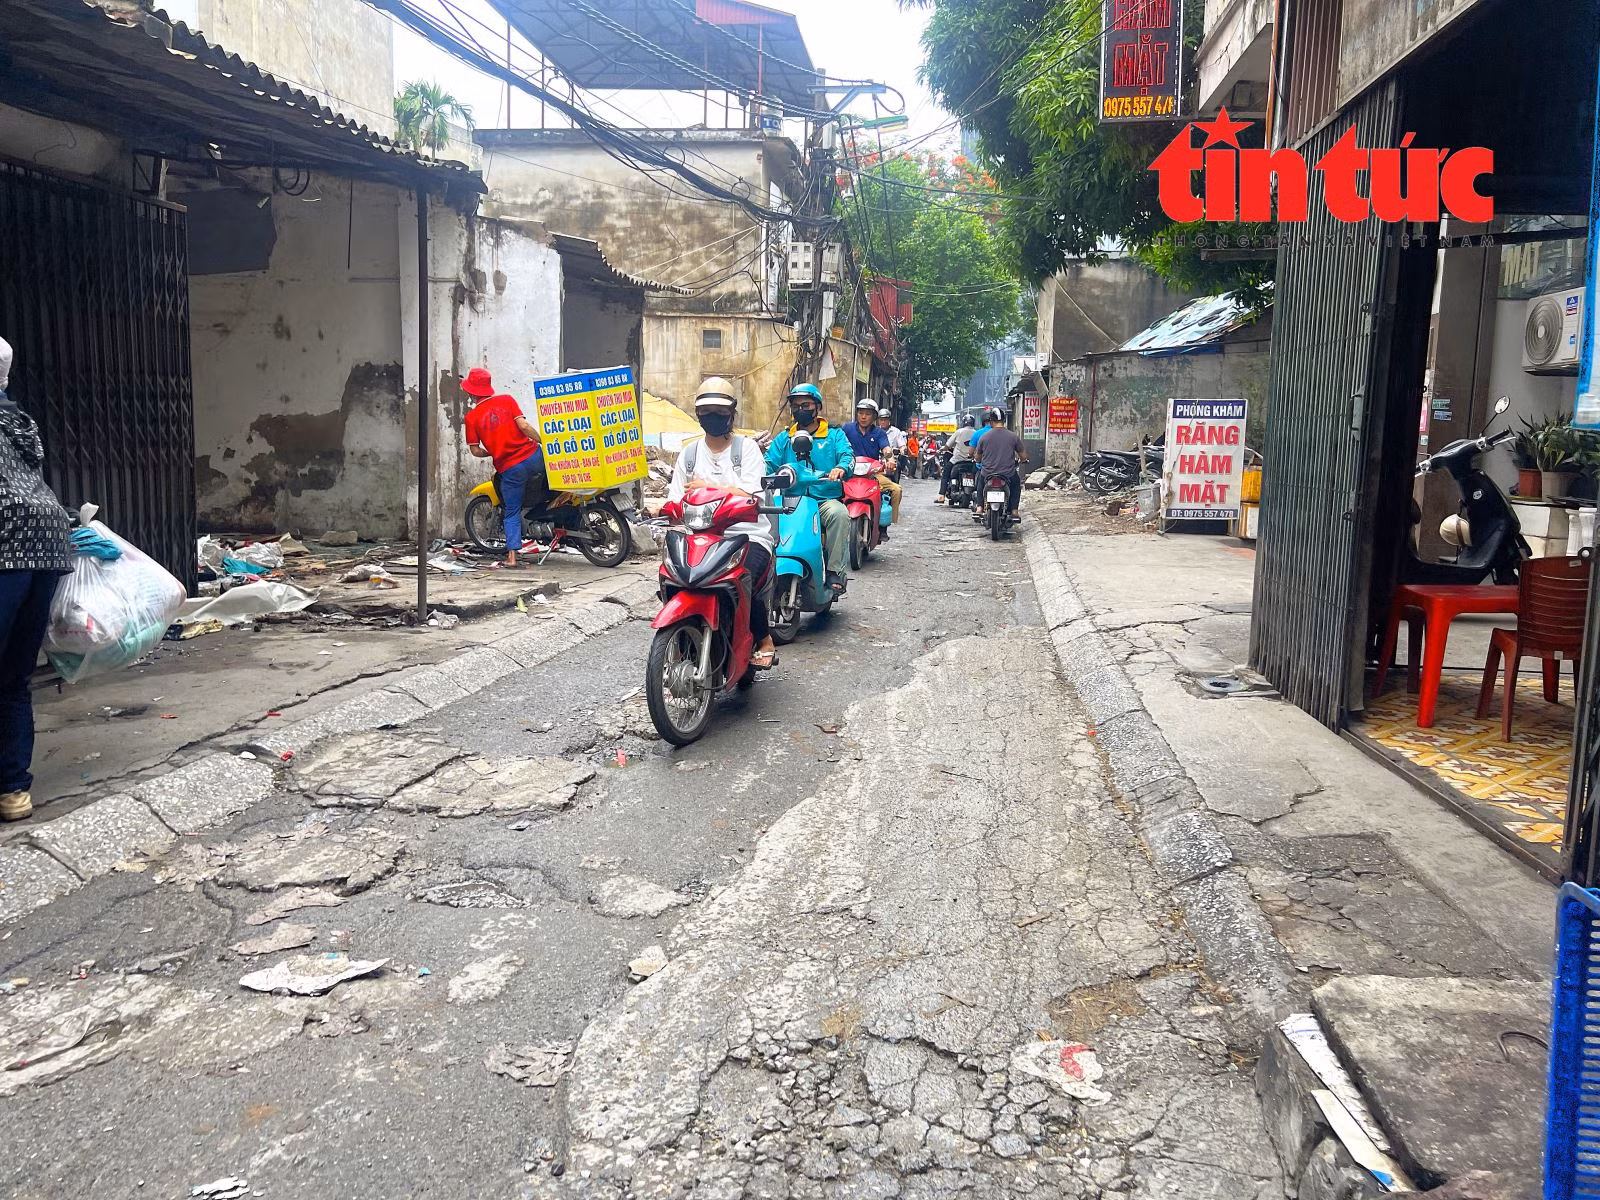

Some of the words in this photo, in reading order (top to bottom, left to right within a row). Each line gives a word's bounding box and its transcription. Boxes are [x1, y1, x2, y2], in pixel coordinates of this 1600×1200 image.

[1113, 34, 1169, 96] MẶT
[1104, 97, 1131, 117] 0975
[1132, 96, 1153, 116] 557
[555, 384, 565, 394] 83
[540, 401, 563, 416] CHUYÊN
[563, 400, 575, 413] THU
[575, 398, 589, 411] MUA
[1024, 397, 1040, 407] TIVI
[1212, 402, 1244, 417] KHÁM
[600, 411, 617, 426] CÁC
[618, 408, 636, 423] LOẠI
[1024, 408, 1040, 418] LCD
[544, 418, 565, 434] CÁC
[567, 416, 592, 432] LOẠI
[1176, 421, 1240, 445] RĂNG
[564, 435, 579, 453] GỖ
[580, 435, 596, 451] CŨ
[616, 427, 628, 445] GỖ
[628, 426, 640, 442] CŨ
[1179, 450, 1233, 475] HÀM
[1179, 480, 1230, 508] MẶT
[1183, 509, 1203, 517] 0975
[1203, 509, 1218, 517] 557
